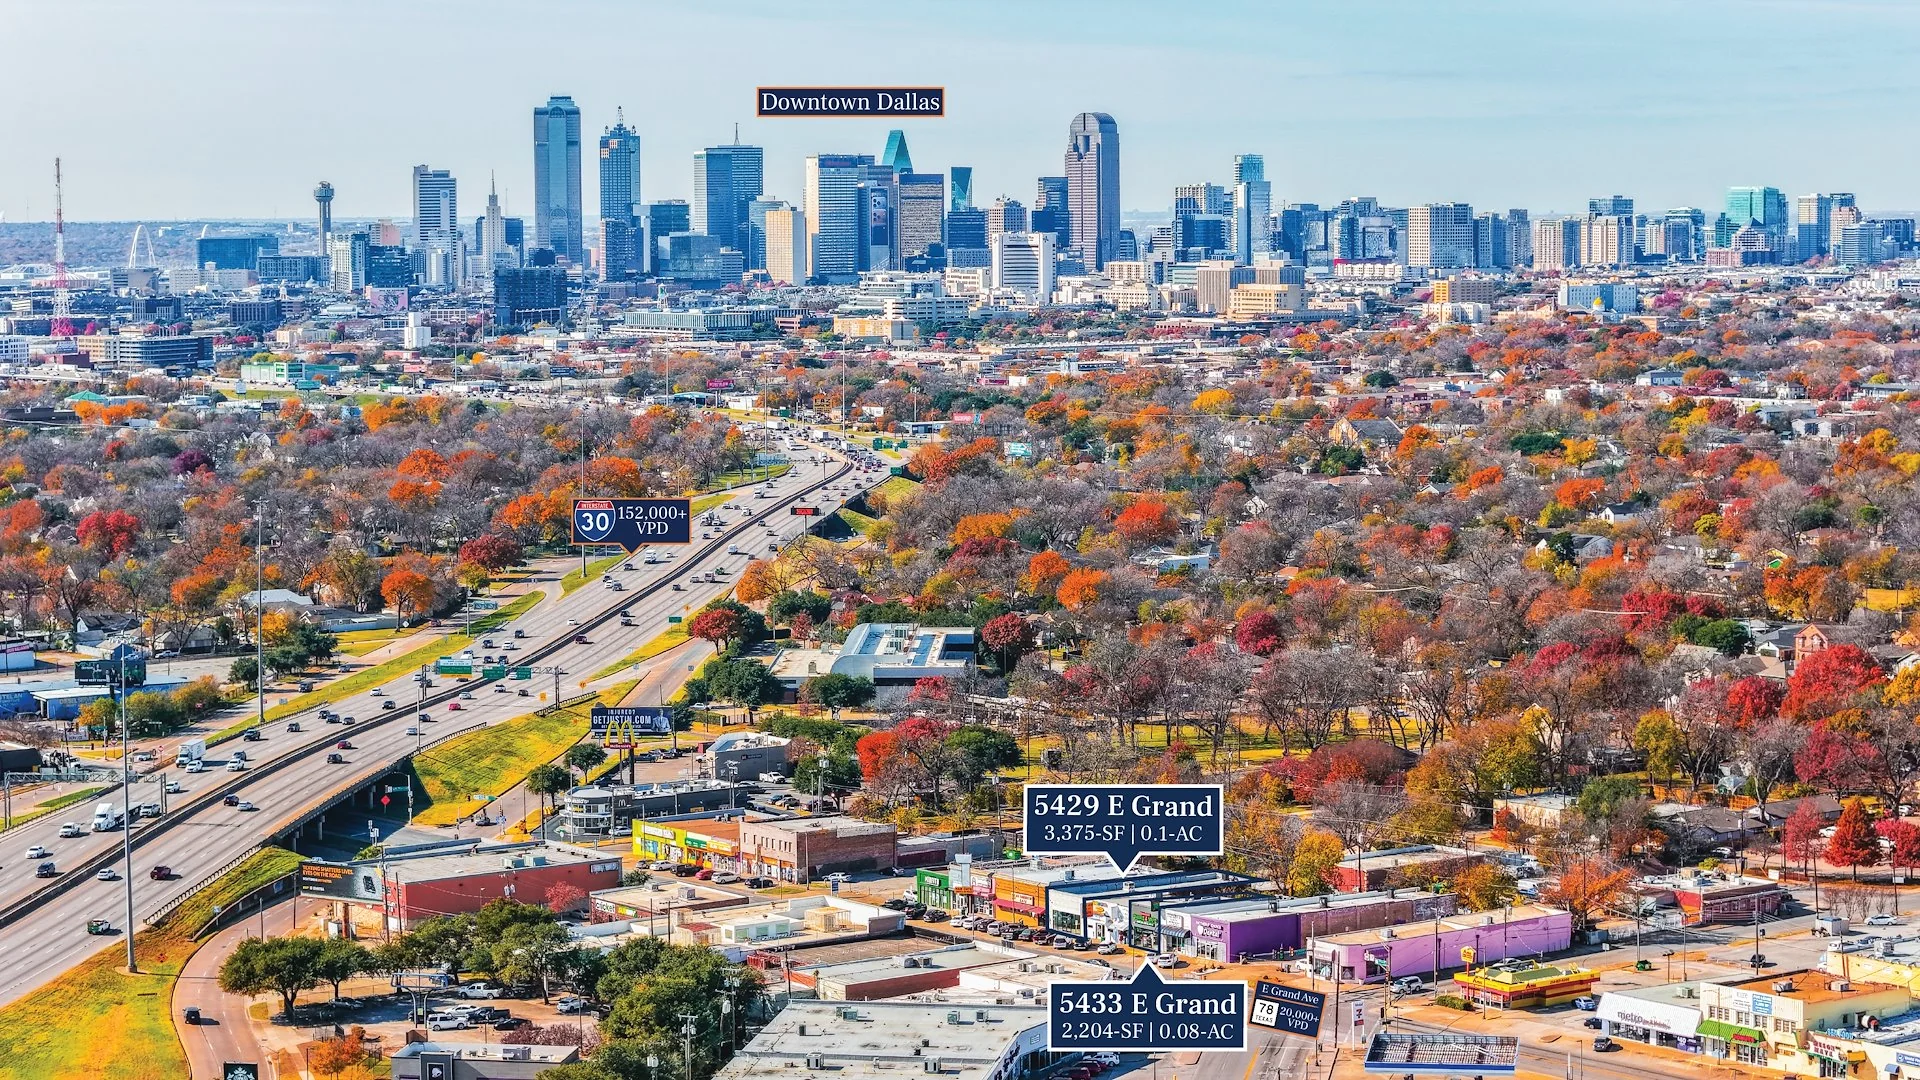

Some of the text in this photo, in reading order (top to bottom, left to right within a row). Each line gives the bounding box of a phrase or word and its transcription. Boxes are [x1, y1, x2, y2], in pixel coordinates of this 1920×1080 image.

[593, 715, 652, 725] GETJUSTIN.COM
[597, 901, 615, 913] cricket
[1617, 1011, 1643, 1024] metro
